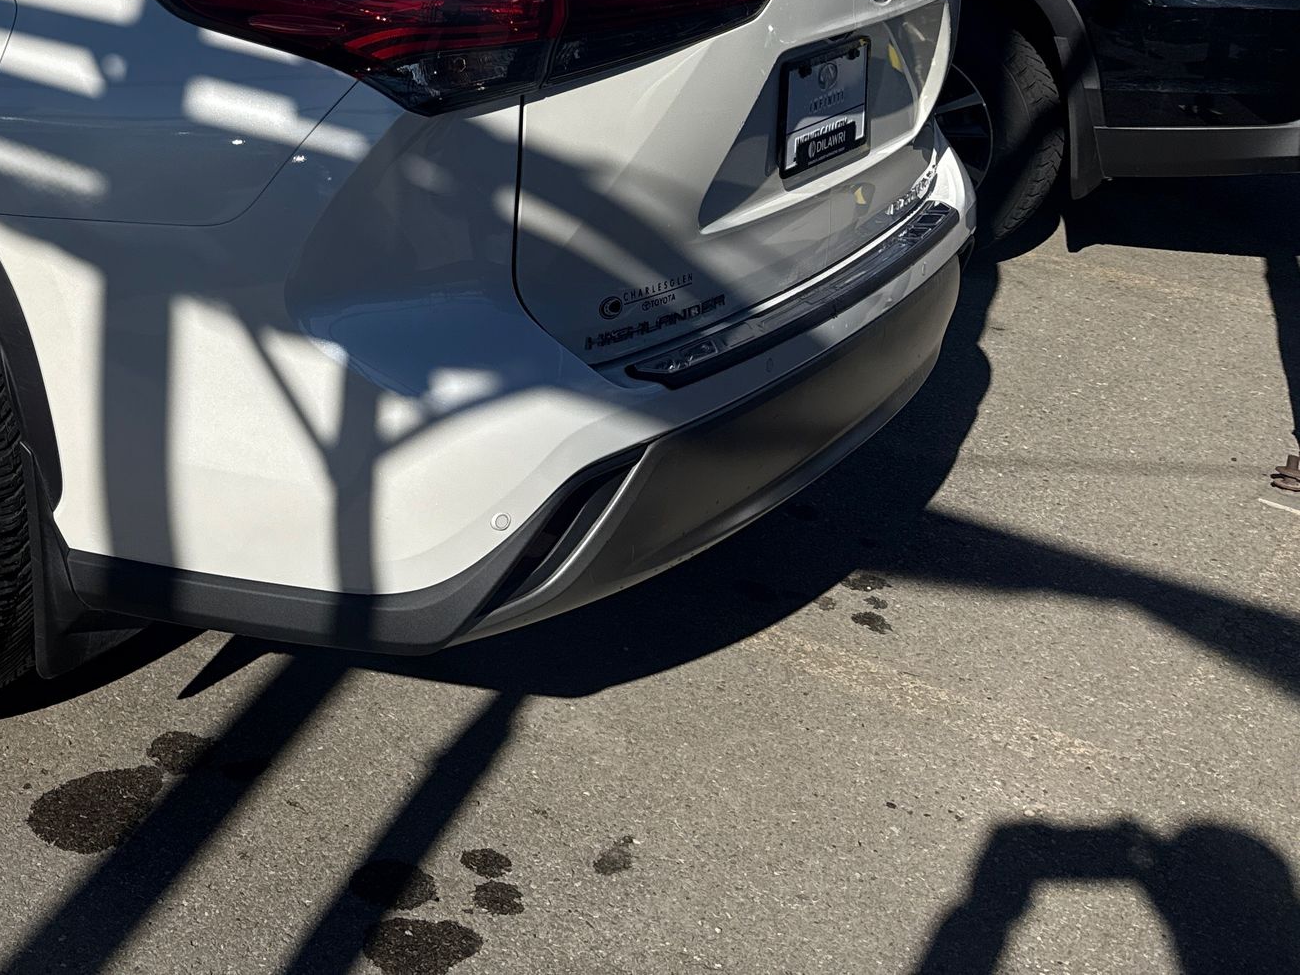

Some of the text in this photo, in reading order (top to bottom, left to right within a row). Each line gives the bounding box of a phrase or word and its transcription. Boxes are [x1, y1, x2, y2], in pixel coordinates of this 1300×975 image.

[816, 131, 847, 153] DILAWRI
[623, 273, 693, 301] CHARLESGLEN
[651, 293, 676, 309] TOYOTA
[585, 294, 726, 350] HIGHLANDER
